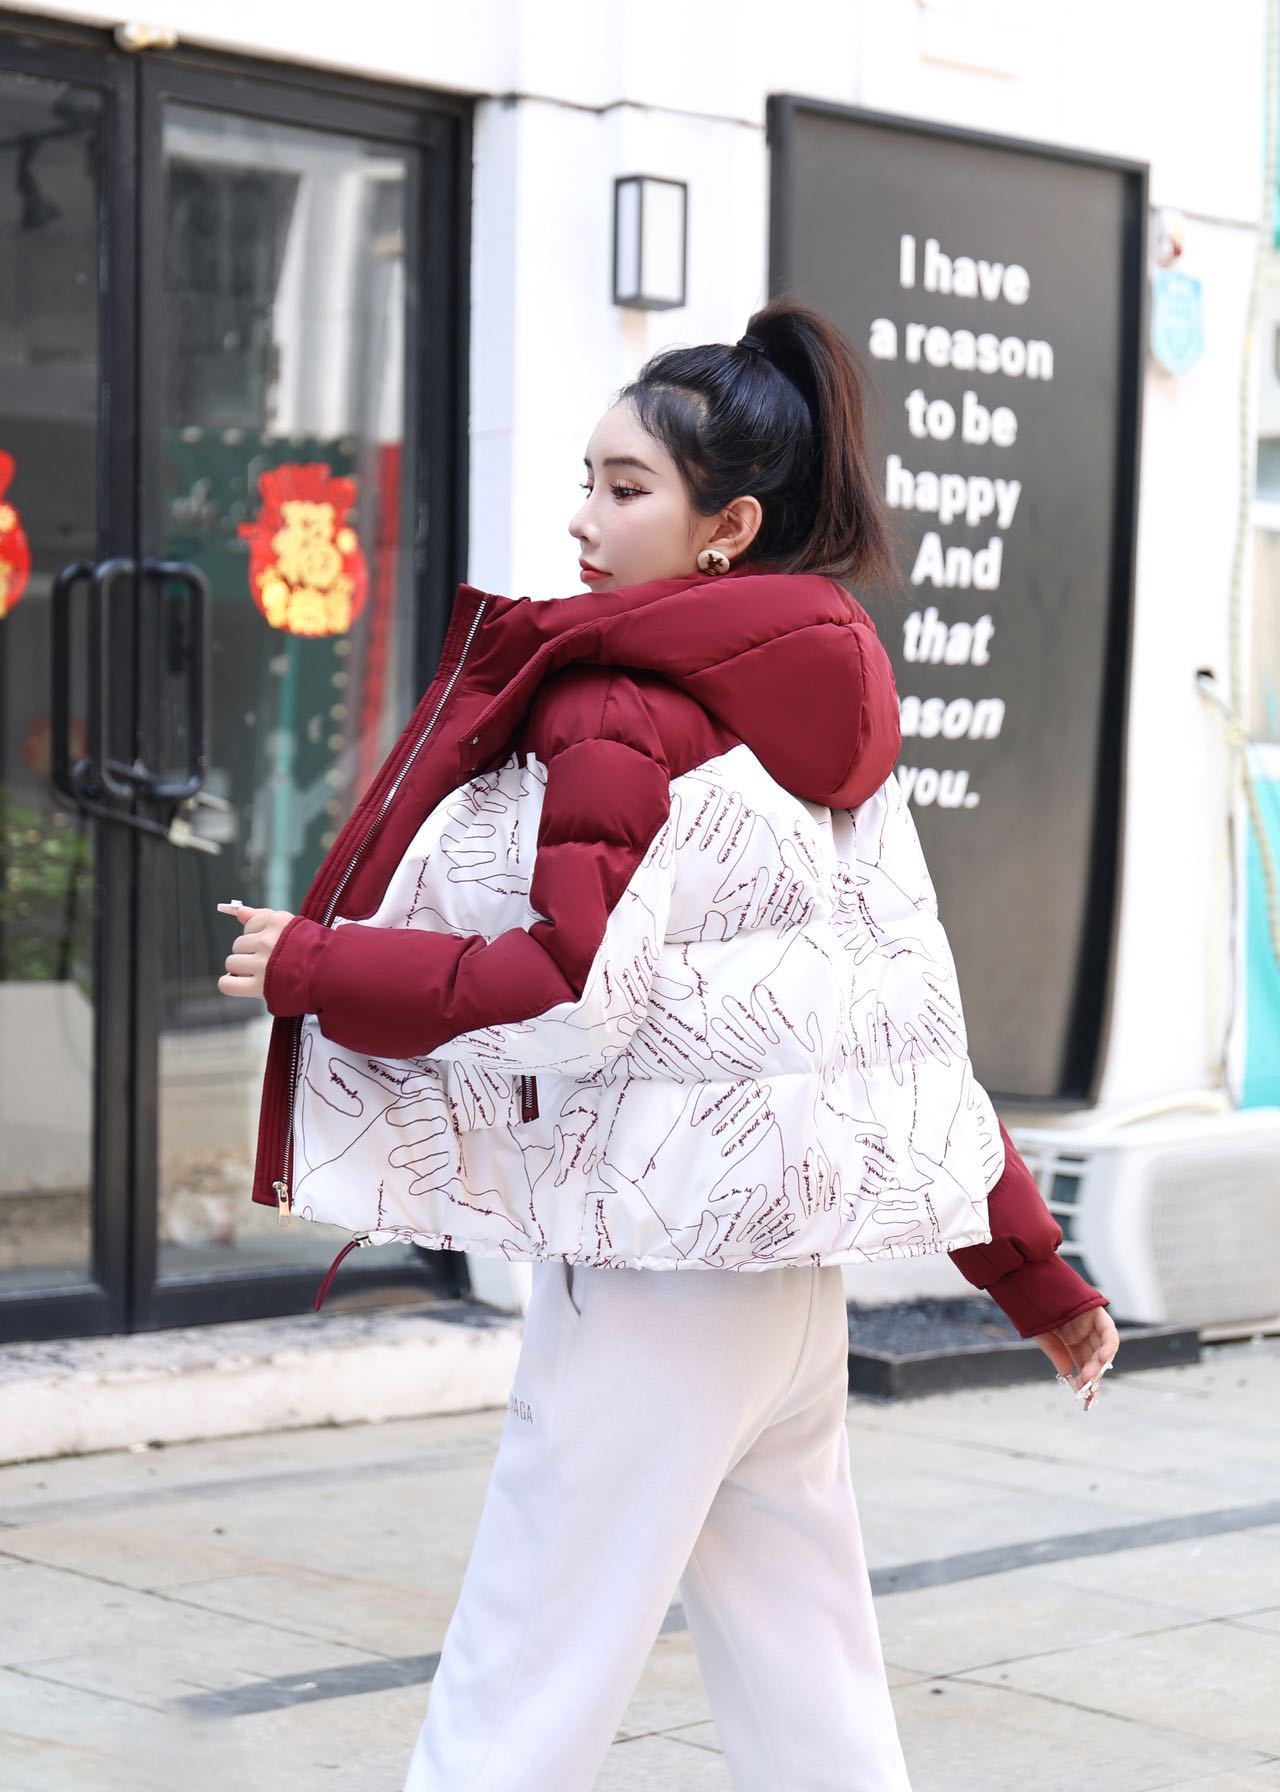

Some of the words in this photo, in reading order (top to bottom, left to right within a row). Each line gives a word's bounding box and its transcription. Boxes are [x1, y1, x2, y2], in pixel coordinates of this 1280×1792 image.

[899, 234, 916, 289] I
[924, 238, 1031, 305] have
[868, 317, 898, 360] a
[905, 322, 1054, 381] reason
[904, 388, 956, 441] to
[961, 390, 1018, 447] be
[885, 453, 1022, 529] happy
[911, 531, 1003, 590] And
[903, 606, 995, 666] that
[898, 764, 980, 808] you.
[661, 1036, 690, 1060] garment
[666, 1012, 695, 1033] garment
[713, 1085, 737, 1112] garment
[729, 1096, 752, 1125] garment
[738, 1118, 762, 1148] garment
